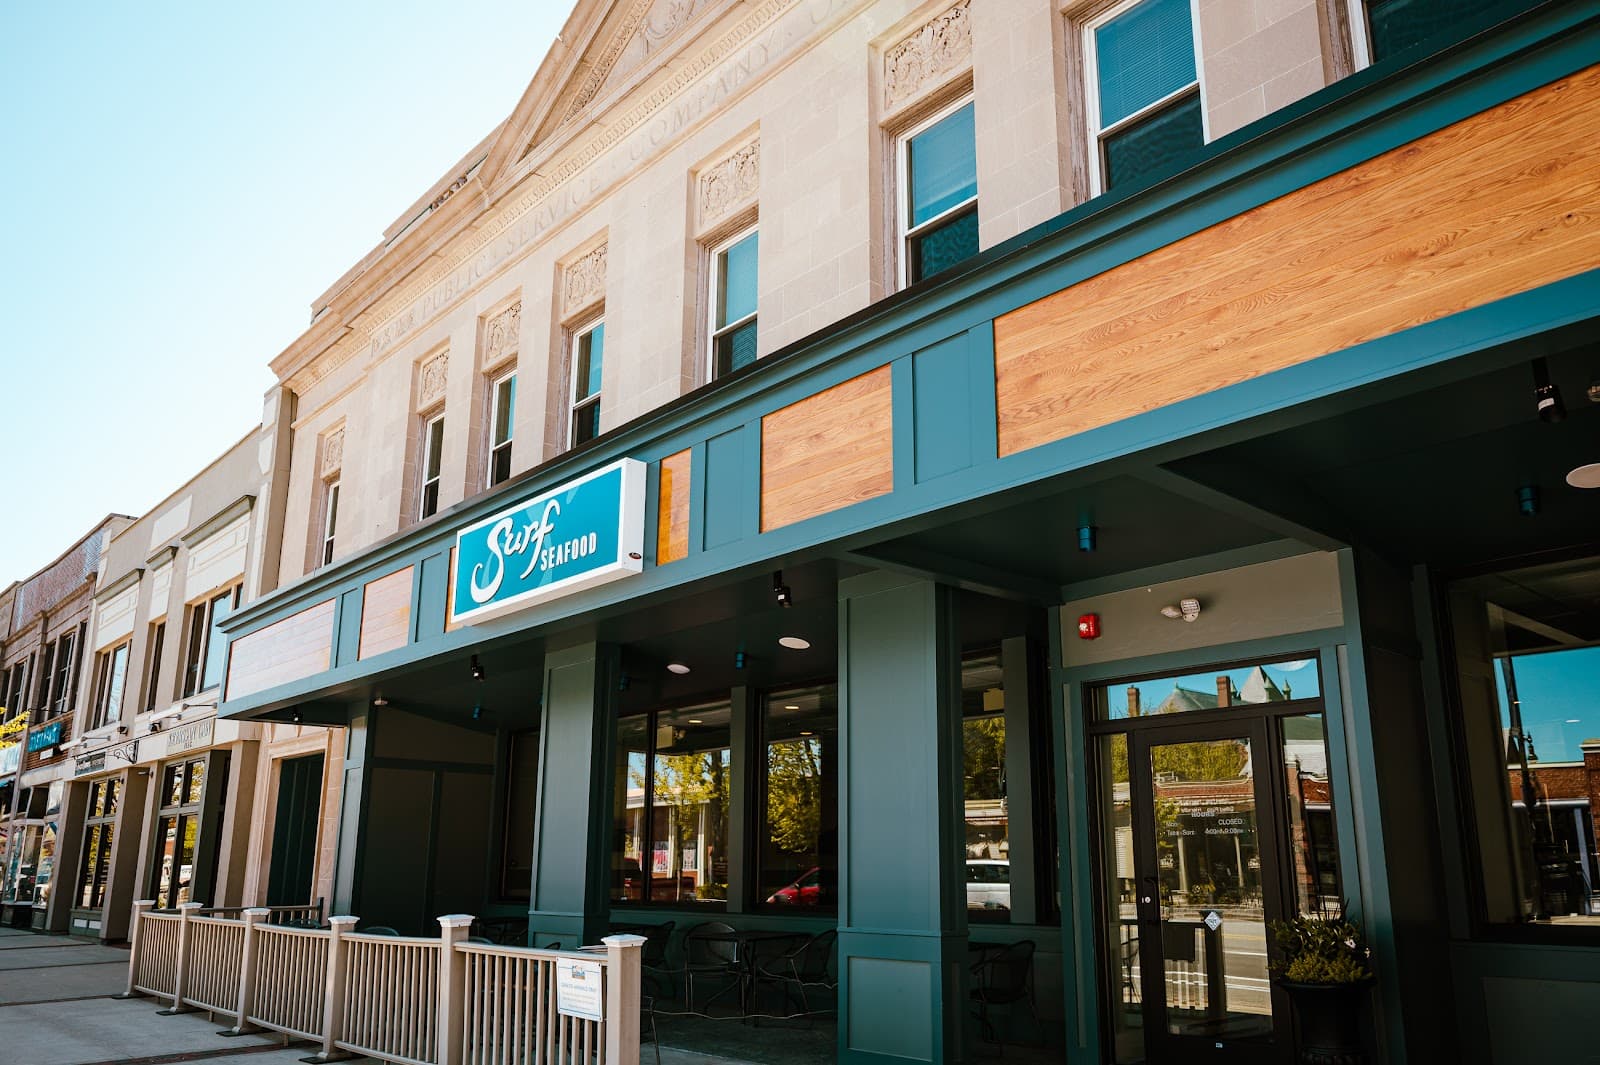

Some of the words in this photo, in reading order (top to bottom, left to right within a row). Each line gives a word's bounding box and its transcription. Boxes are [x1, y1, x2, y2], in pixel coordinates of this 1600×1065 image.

[422, 254, 487, 319] PUBLIC
[505, 177, 602, 256] SERVICE
[628, 29, 776, 161] COMPANY
[470, 498, 561, 604] Surf
[540, 532, 597, 572] SEAFOOD
[1218, 818, 1243, 826] CLOSED
